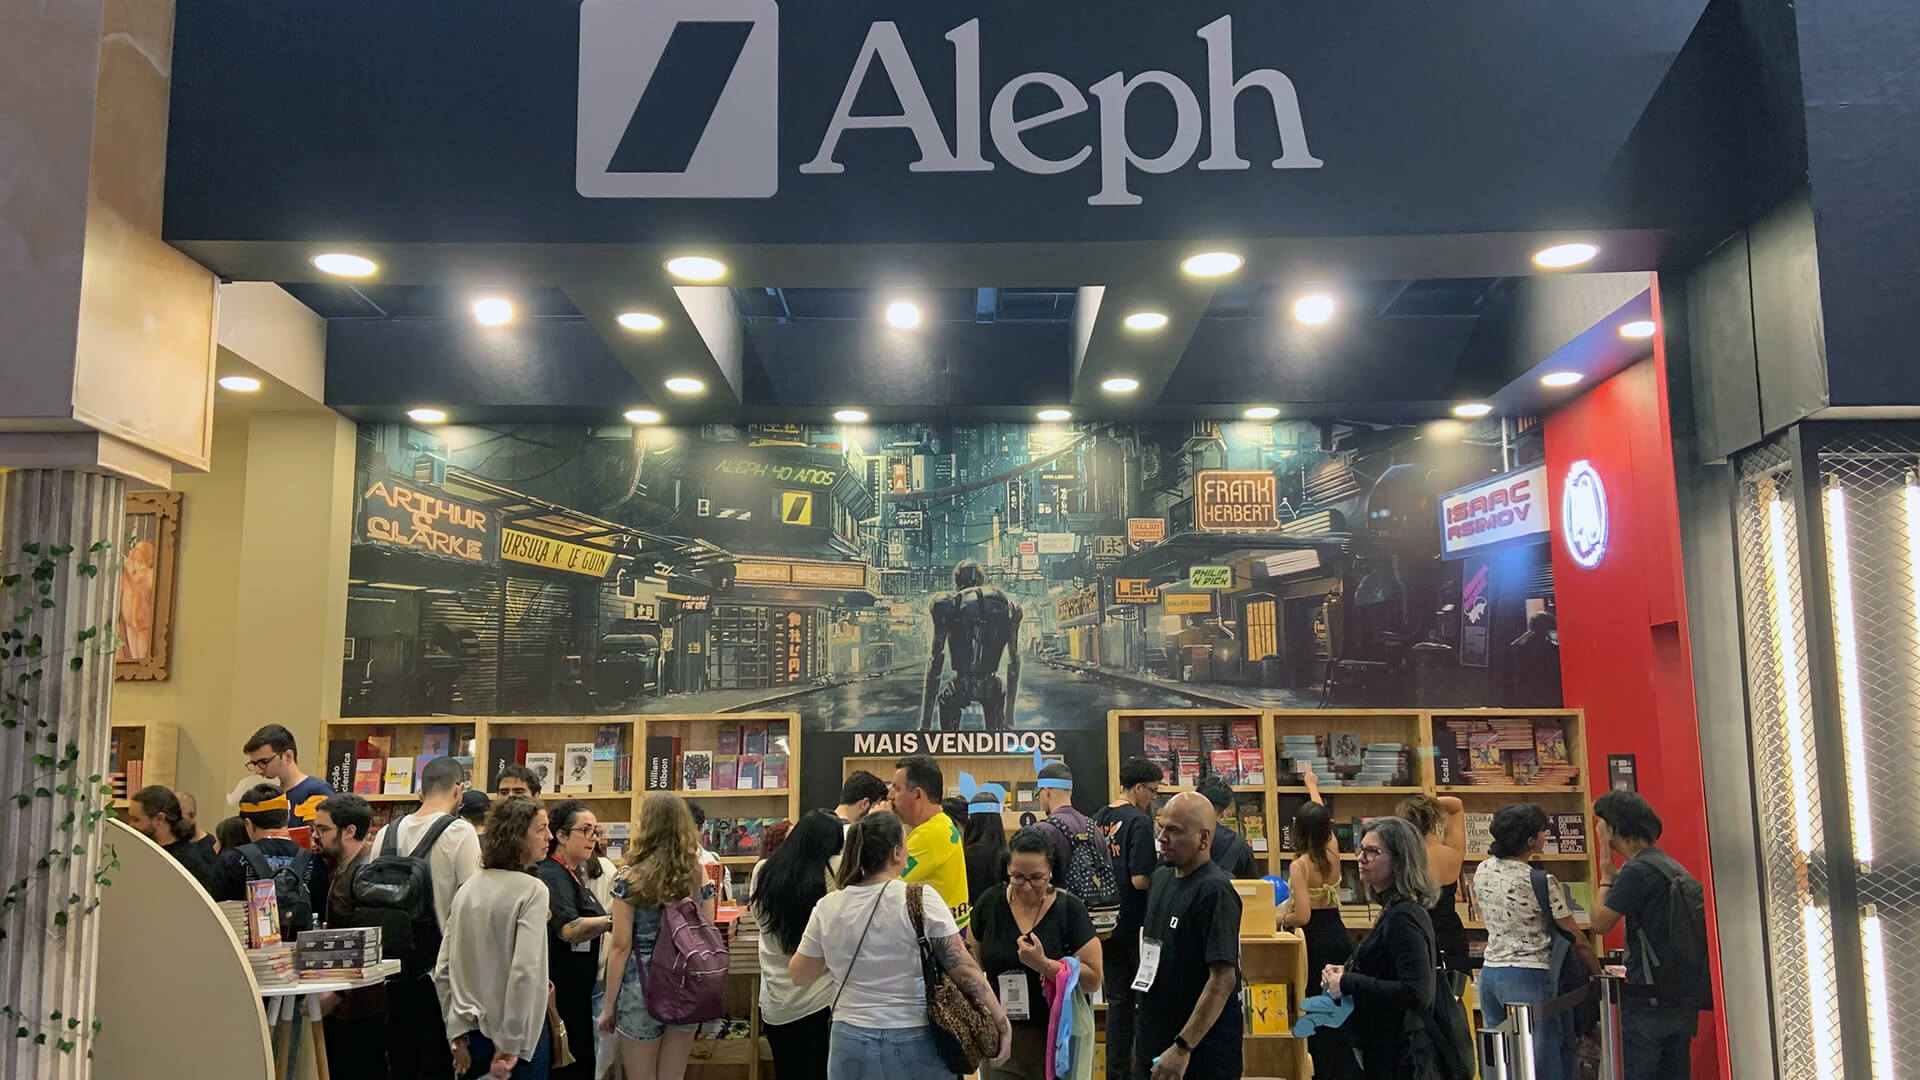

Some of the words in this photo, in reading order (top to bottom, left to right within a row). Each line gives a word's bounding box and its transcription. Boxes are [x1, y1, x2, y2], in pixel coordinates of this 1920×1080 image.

[799, 14, 1324, 204] Aleph
[715, 459, 769, 478] ALEPH
[773, 465, 792, 481] 40
[794, 468, 836, 486] ANOS
[1204, 480, 1271, 503] FRANK
[1446, 479, 1531, 525] ISAAC
[364, 480, 487, 533] ARTHUR
[1204, 504, 1272, 521] HERBERT
[1446, 503, 1531, 541] ASIMOV
[366, 516, 483, 561] CLARKE
[502, 531, 545, 563] URSULA
[567, 547, 582, 569] LE
[581, 551, 608, 573] GUIN
[741, 566, 787, 579] JOHN
[795, 568, 858, 583] SCALZI
[1192, 569, 1229, 578] PHILIP
[1203, 577, 1229, 585] DICK
[1117, 581, 1158, 596] LEM
[854, 732, 919, 754] MAIS
[924, 731, 1057, 754] VENDIDOS
[331, 765, 341, 792] icção
[340, 752, 352, 792] científica
[650, 757, 659, 788] William
[659, 758, 669, 789] Gibson
[1441, 758, 1450, 783] Scalzi
[1282, 825, 1291, 850] Frank
